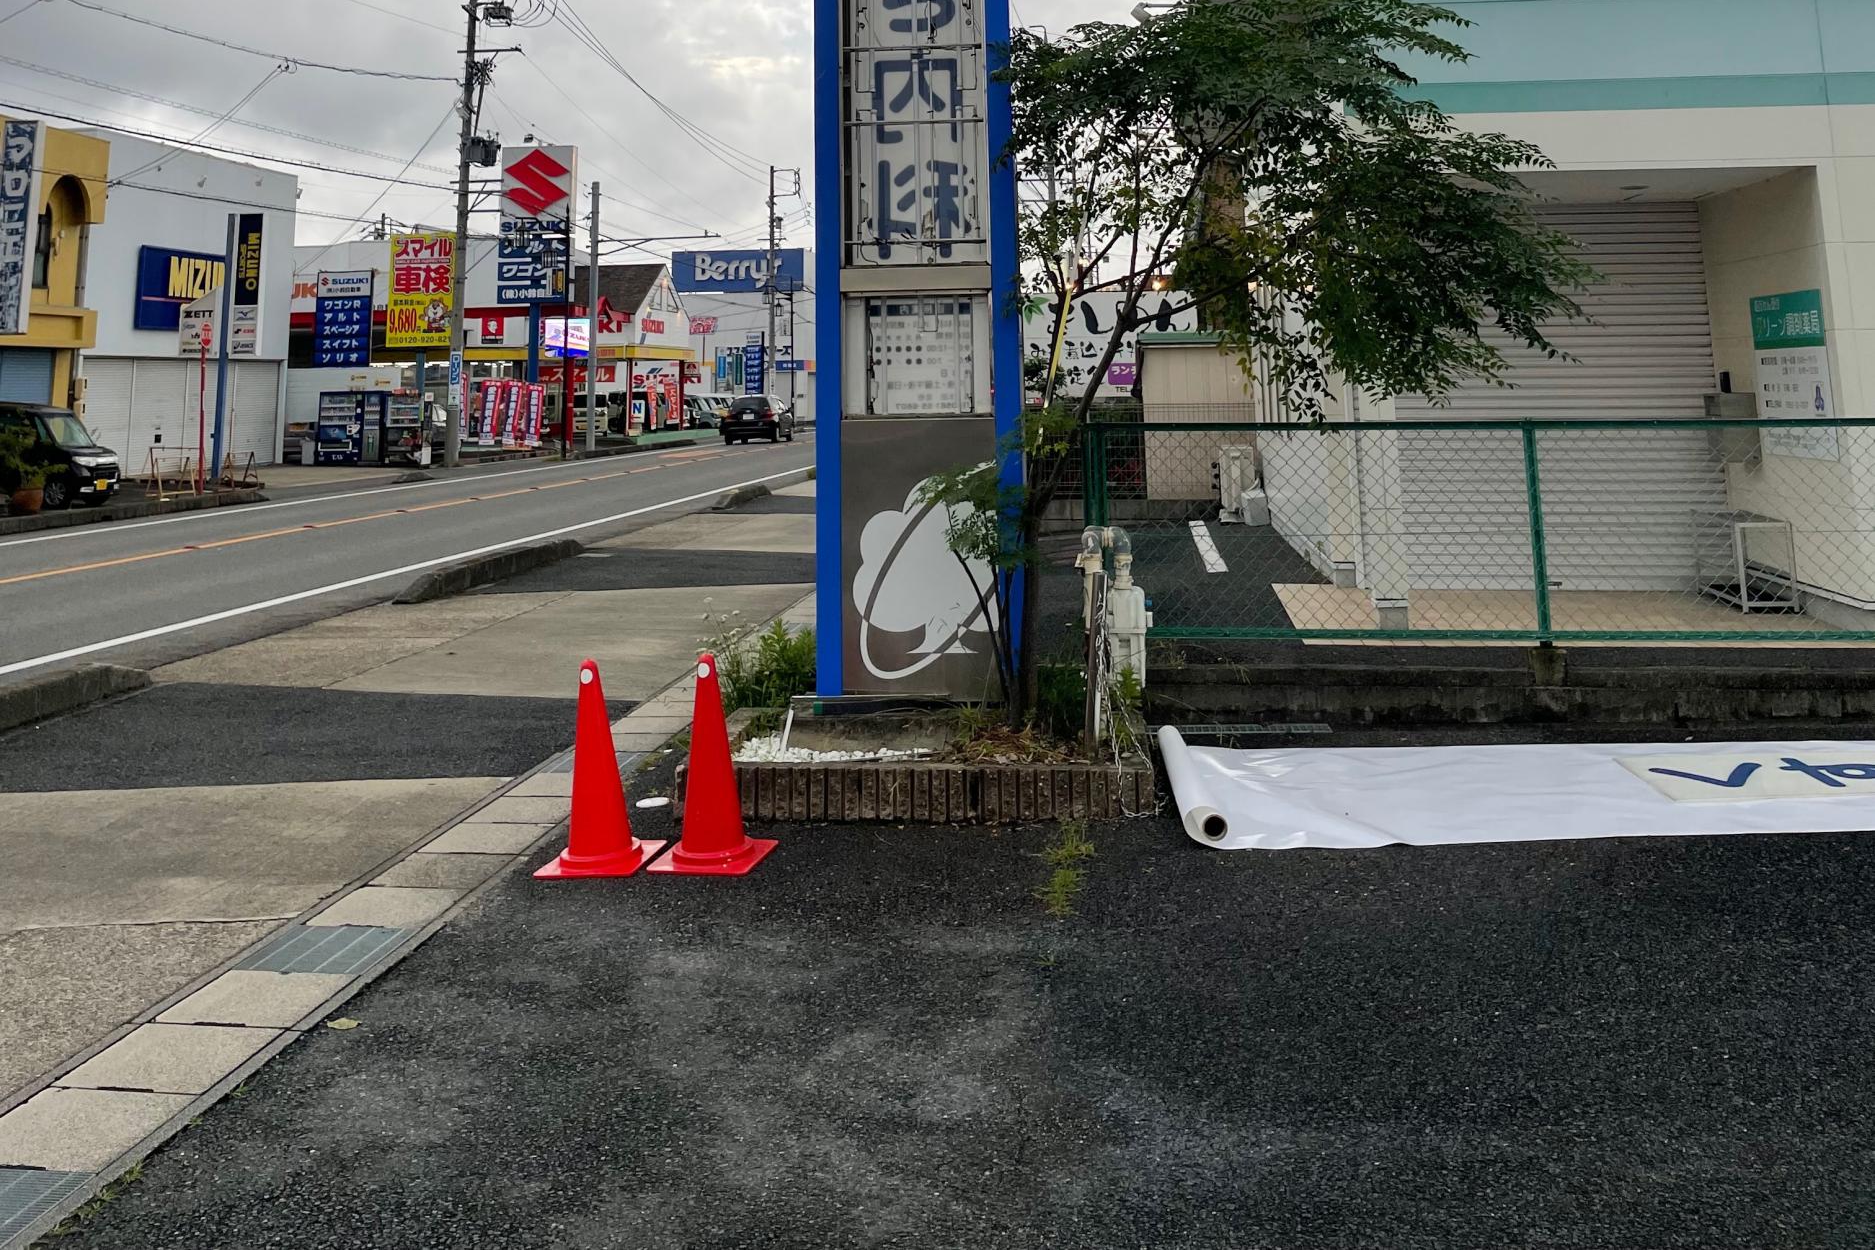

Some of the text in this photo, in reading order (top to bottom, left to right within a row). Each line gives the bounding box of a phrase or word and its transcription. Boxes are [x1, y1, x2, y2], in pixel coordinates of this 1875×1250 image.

[501, 221, 567, 233] SUZUK
[395, 237, 453, 258] スマイル
[245, 232, 261, 291] MIZUNO
[331, 277, 369, 285] SUZUKI
[393, 264, 452, 294] 車検
[324, 300, 361, 310] ワゴンR
[183, 309, 213, 319] ZETT
[324, 312, 360, 322] アルト
[323, 325, 360, 335] スペーシア
[322, 339, 359, 348] スイフト
[322, 353, 358, 363] ソリオ
